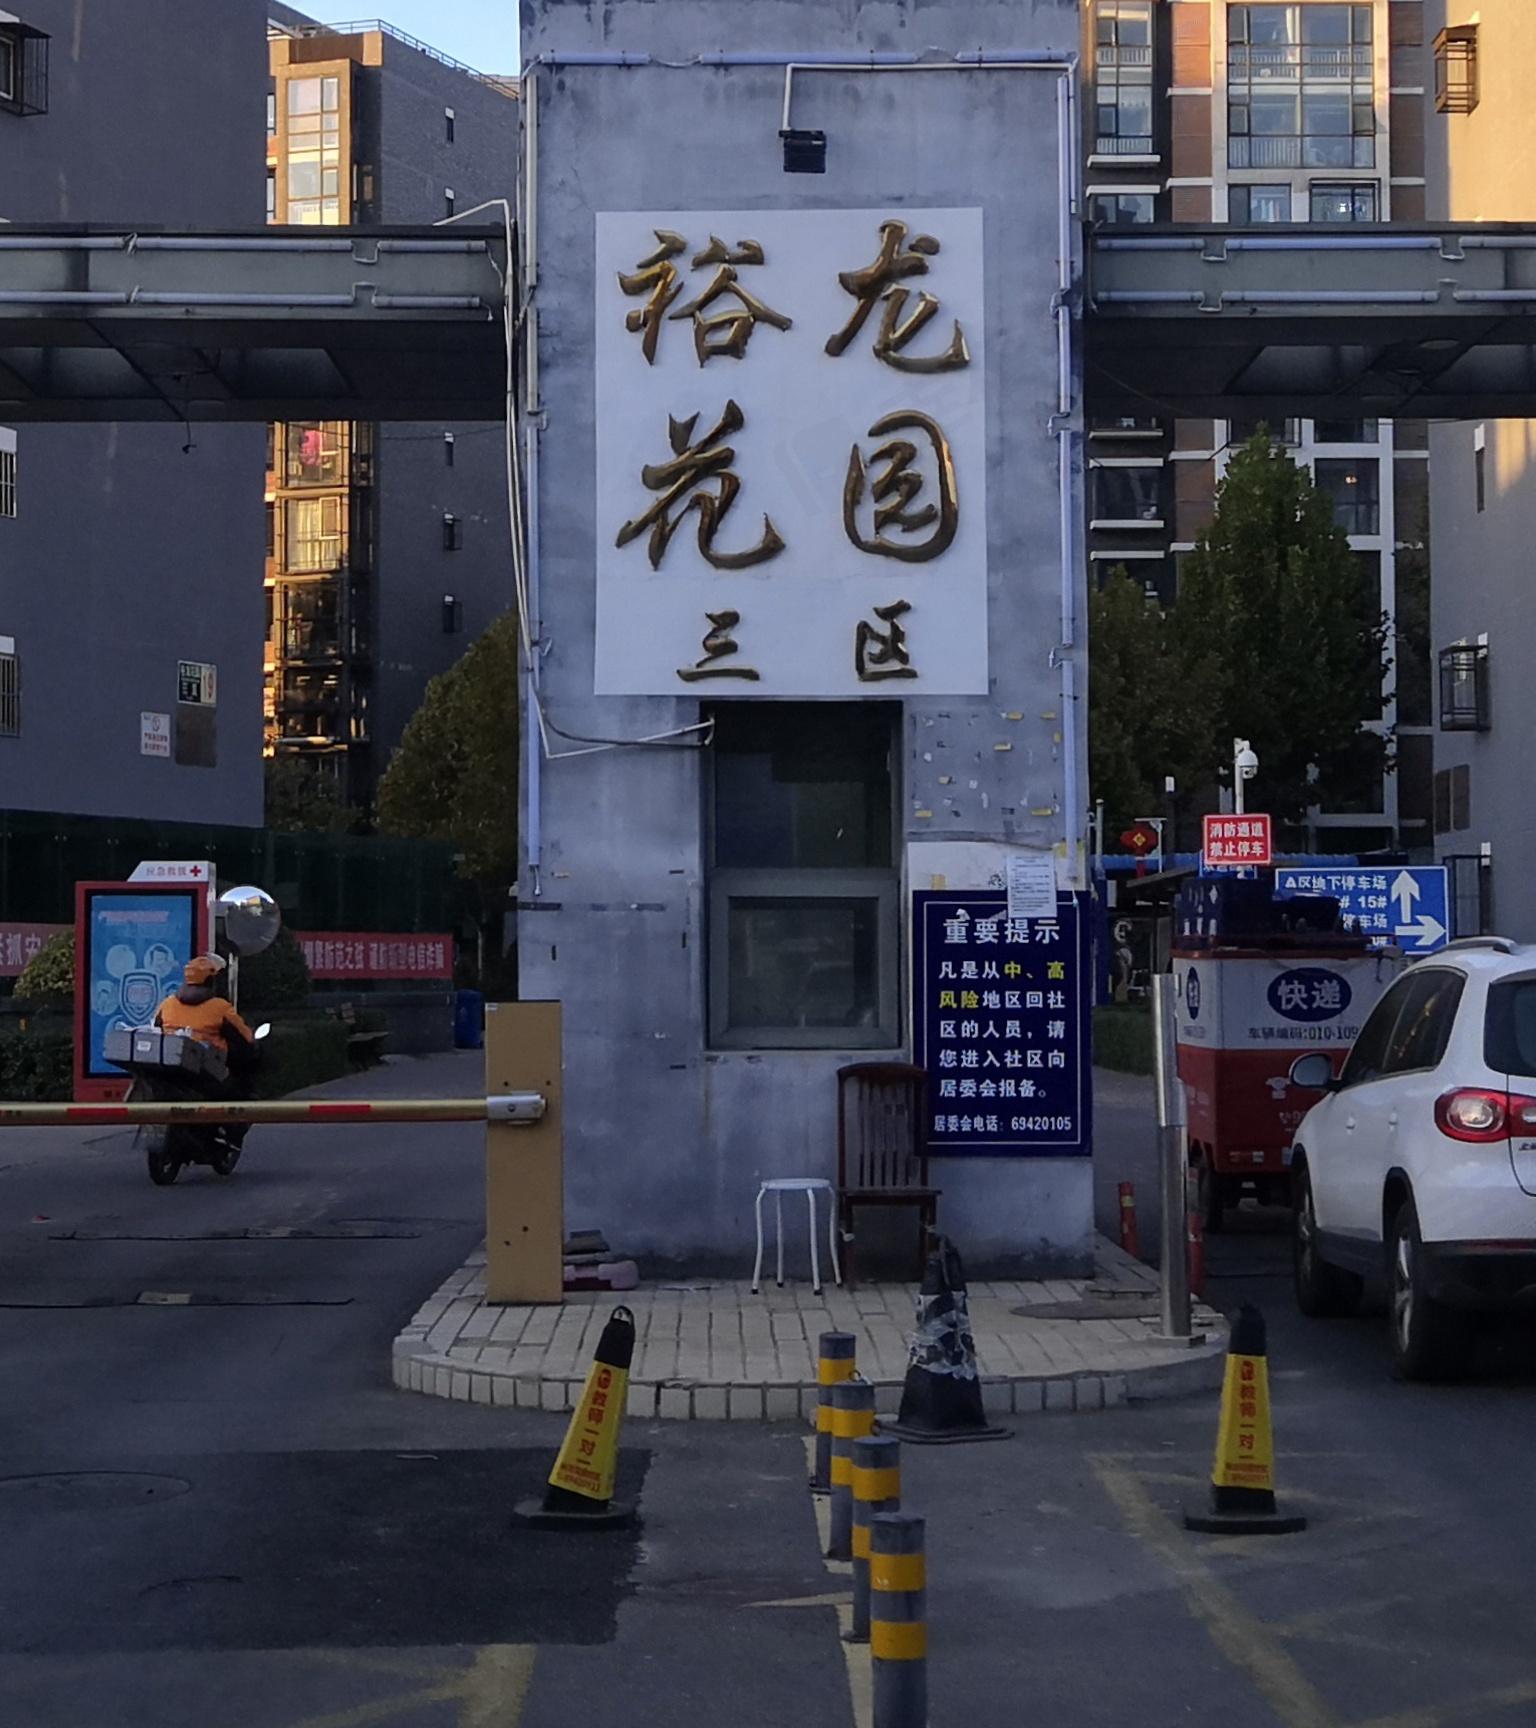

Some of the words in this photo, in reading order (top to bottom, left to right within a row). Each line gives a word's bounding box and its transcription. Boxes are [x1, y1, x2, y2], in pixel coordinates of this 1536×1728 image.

[615, 399, 960, 572] 花园
[676, 600, 919, 683] 三区
[1210, 822, 1264, 838] 消防通道
[1209, 841, 1264, 857] 禁止停车
[1285, 875, 1388, 891] A区地下停车场
[1357, 895, 1388, 909] 15#
[943, 918, 1061, 944] 重要提示
[939, 961, 1066, 980] 凡是从中、高
[939, 991, 1066, 1010] 风险地区回社
[1278, 979, 1342, 1010] 快递
[939, 1050, 1066, 1068] 您进入社区向
[939, 1079, 1047, 1098] 居委会报备。
